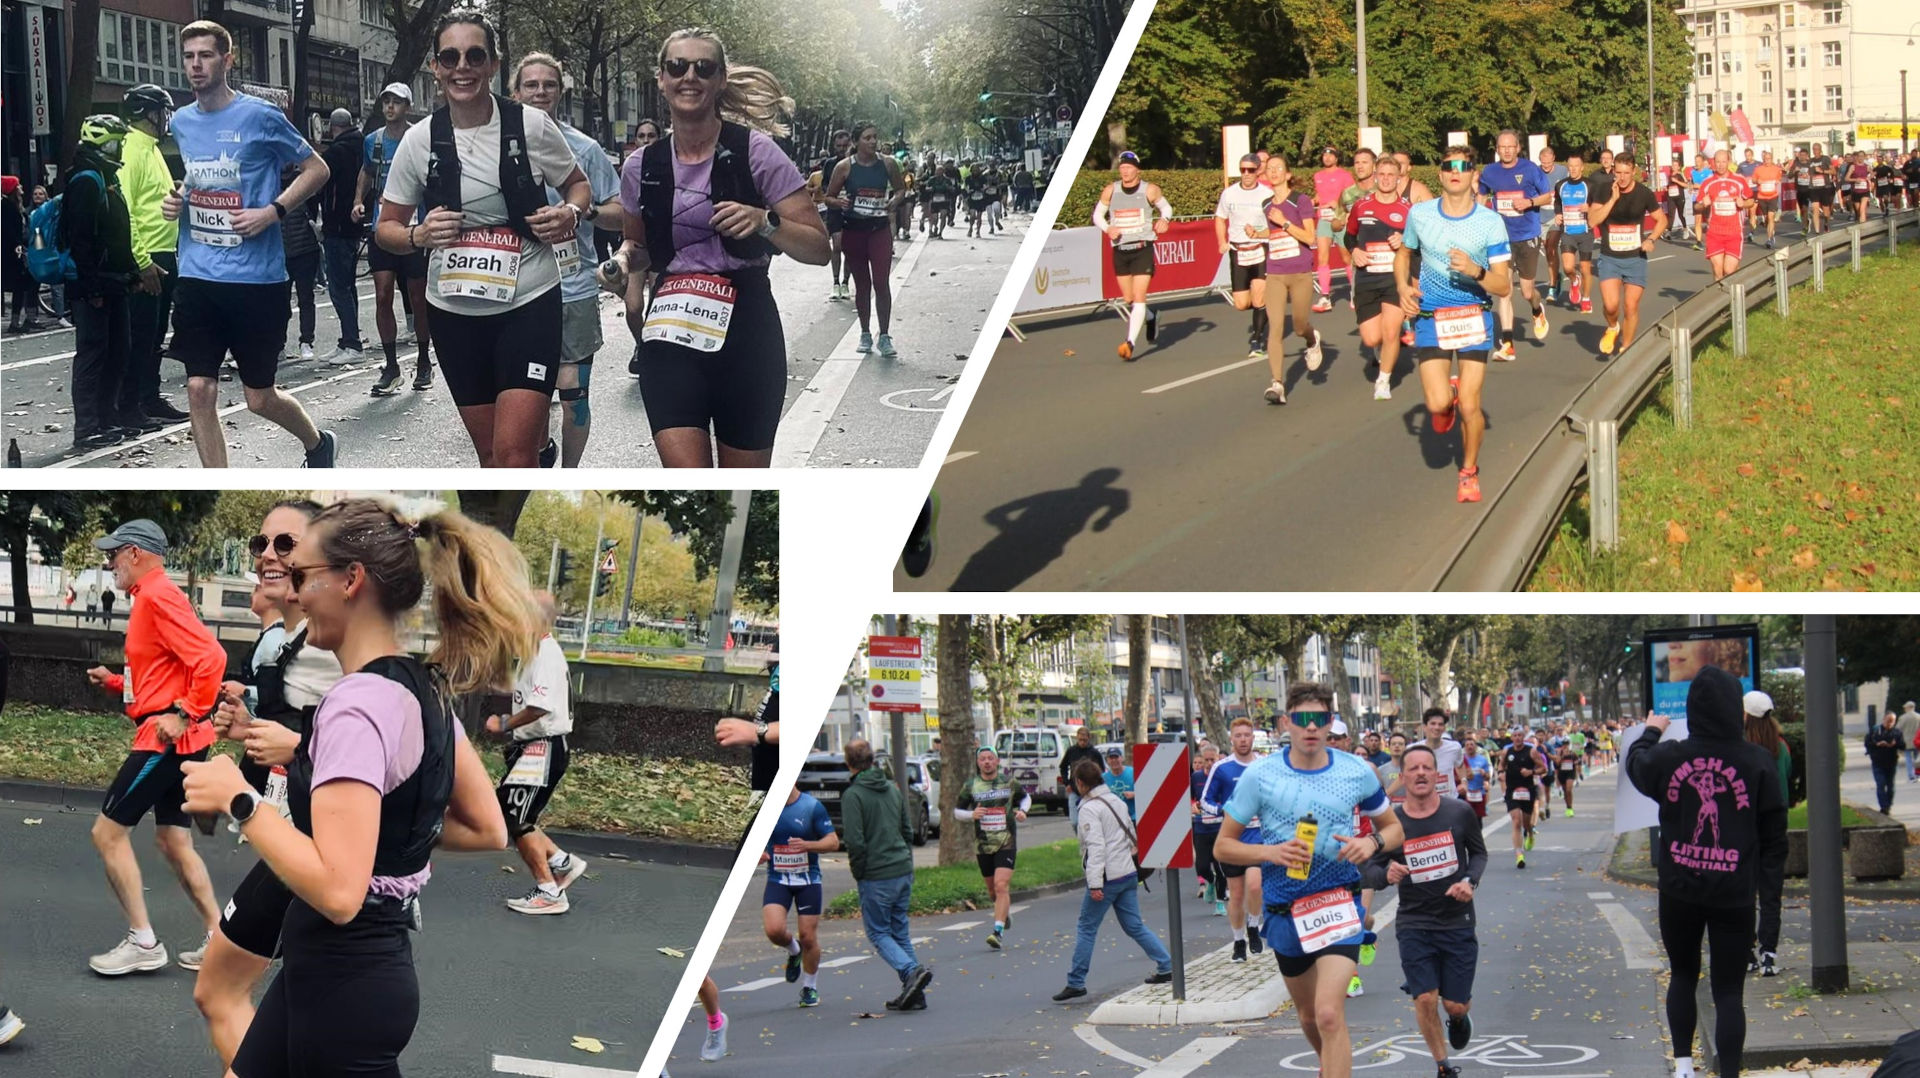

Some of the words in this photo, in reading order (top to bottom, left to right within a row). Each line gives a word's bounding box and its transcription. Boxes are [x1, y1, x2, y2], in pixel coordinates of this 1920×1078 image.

[31, 16, 44, 126] SAUSALITOS
[196, 210, 224, 226] Nick
[462, 230, 519, 247] GENERALI
[446, 252, 502, 272] Sarah
[1153, 240, 1195, 265] NERALI
[508, 255, 518, 276] 5036
[672, 278, 734, 298] GENERALI
[650, 302, 719, 321] Anna-Lena
[718, 306, 730, 328] 5037
[1441, 322, 1474, 334] Louis
[881, 669, 910, 681] 6.10.24
[1667, 757, 1751, 811] GYMSHARK
[506, 787, 528, 807] 10
[1413, 835, 1451, 850] GENERALI
[1670, 840, 1740, 862] LIFTING
[774, 855, 804, 863] Marius
[1410, 850, 1447, 868] Bernd
[1305, 890, 1350, 909] GENERALI
[1302, 910, 1344, 932] Louis
